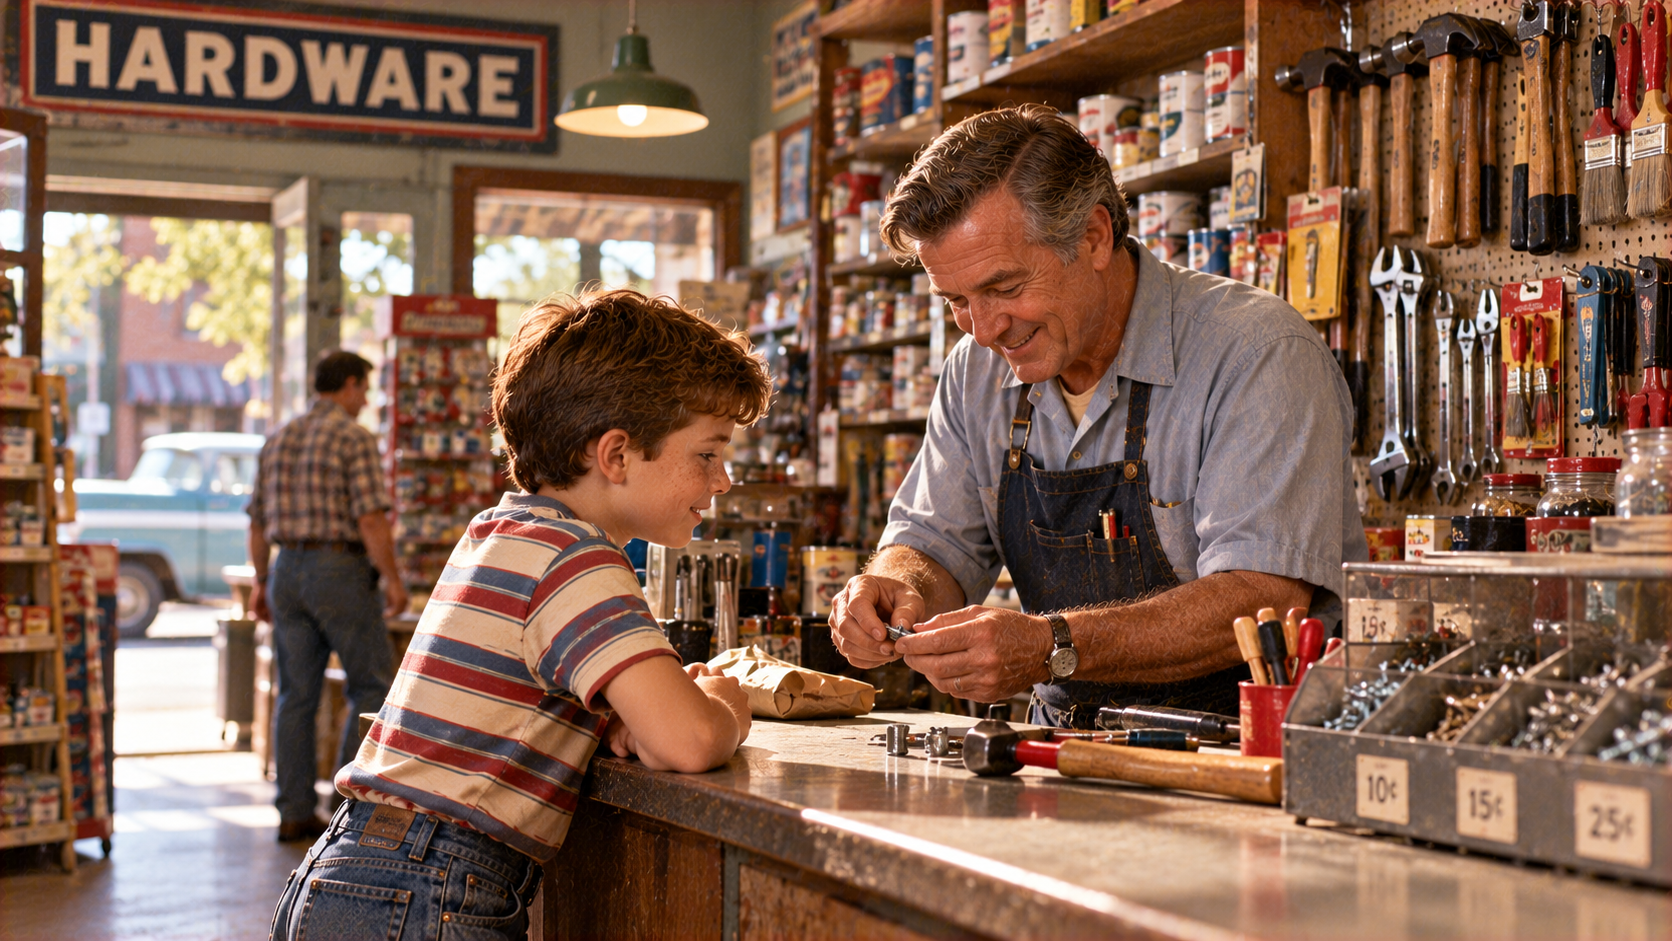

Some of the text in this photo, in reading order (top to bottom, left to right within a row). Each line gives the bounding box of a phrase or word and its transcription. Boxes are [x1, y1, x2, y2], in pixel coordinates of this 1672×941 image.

[55, 19, 520, 118] HARDWARE
[1367, 775, 1397, 803] 10¢
[1470, 789, 1504, 821] 15¢
[1590, 806, 1637, 840] 25¢
